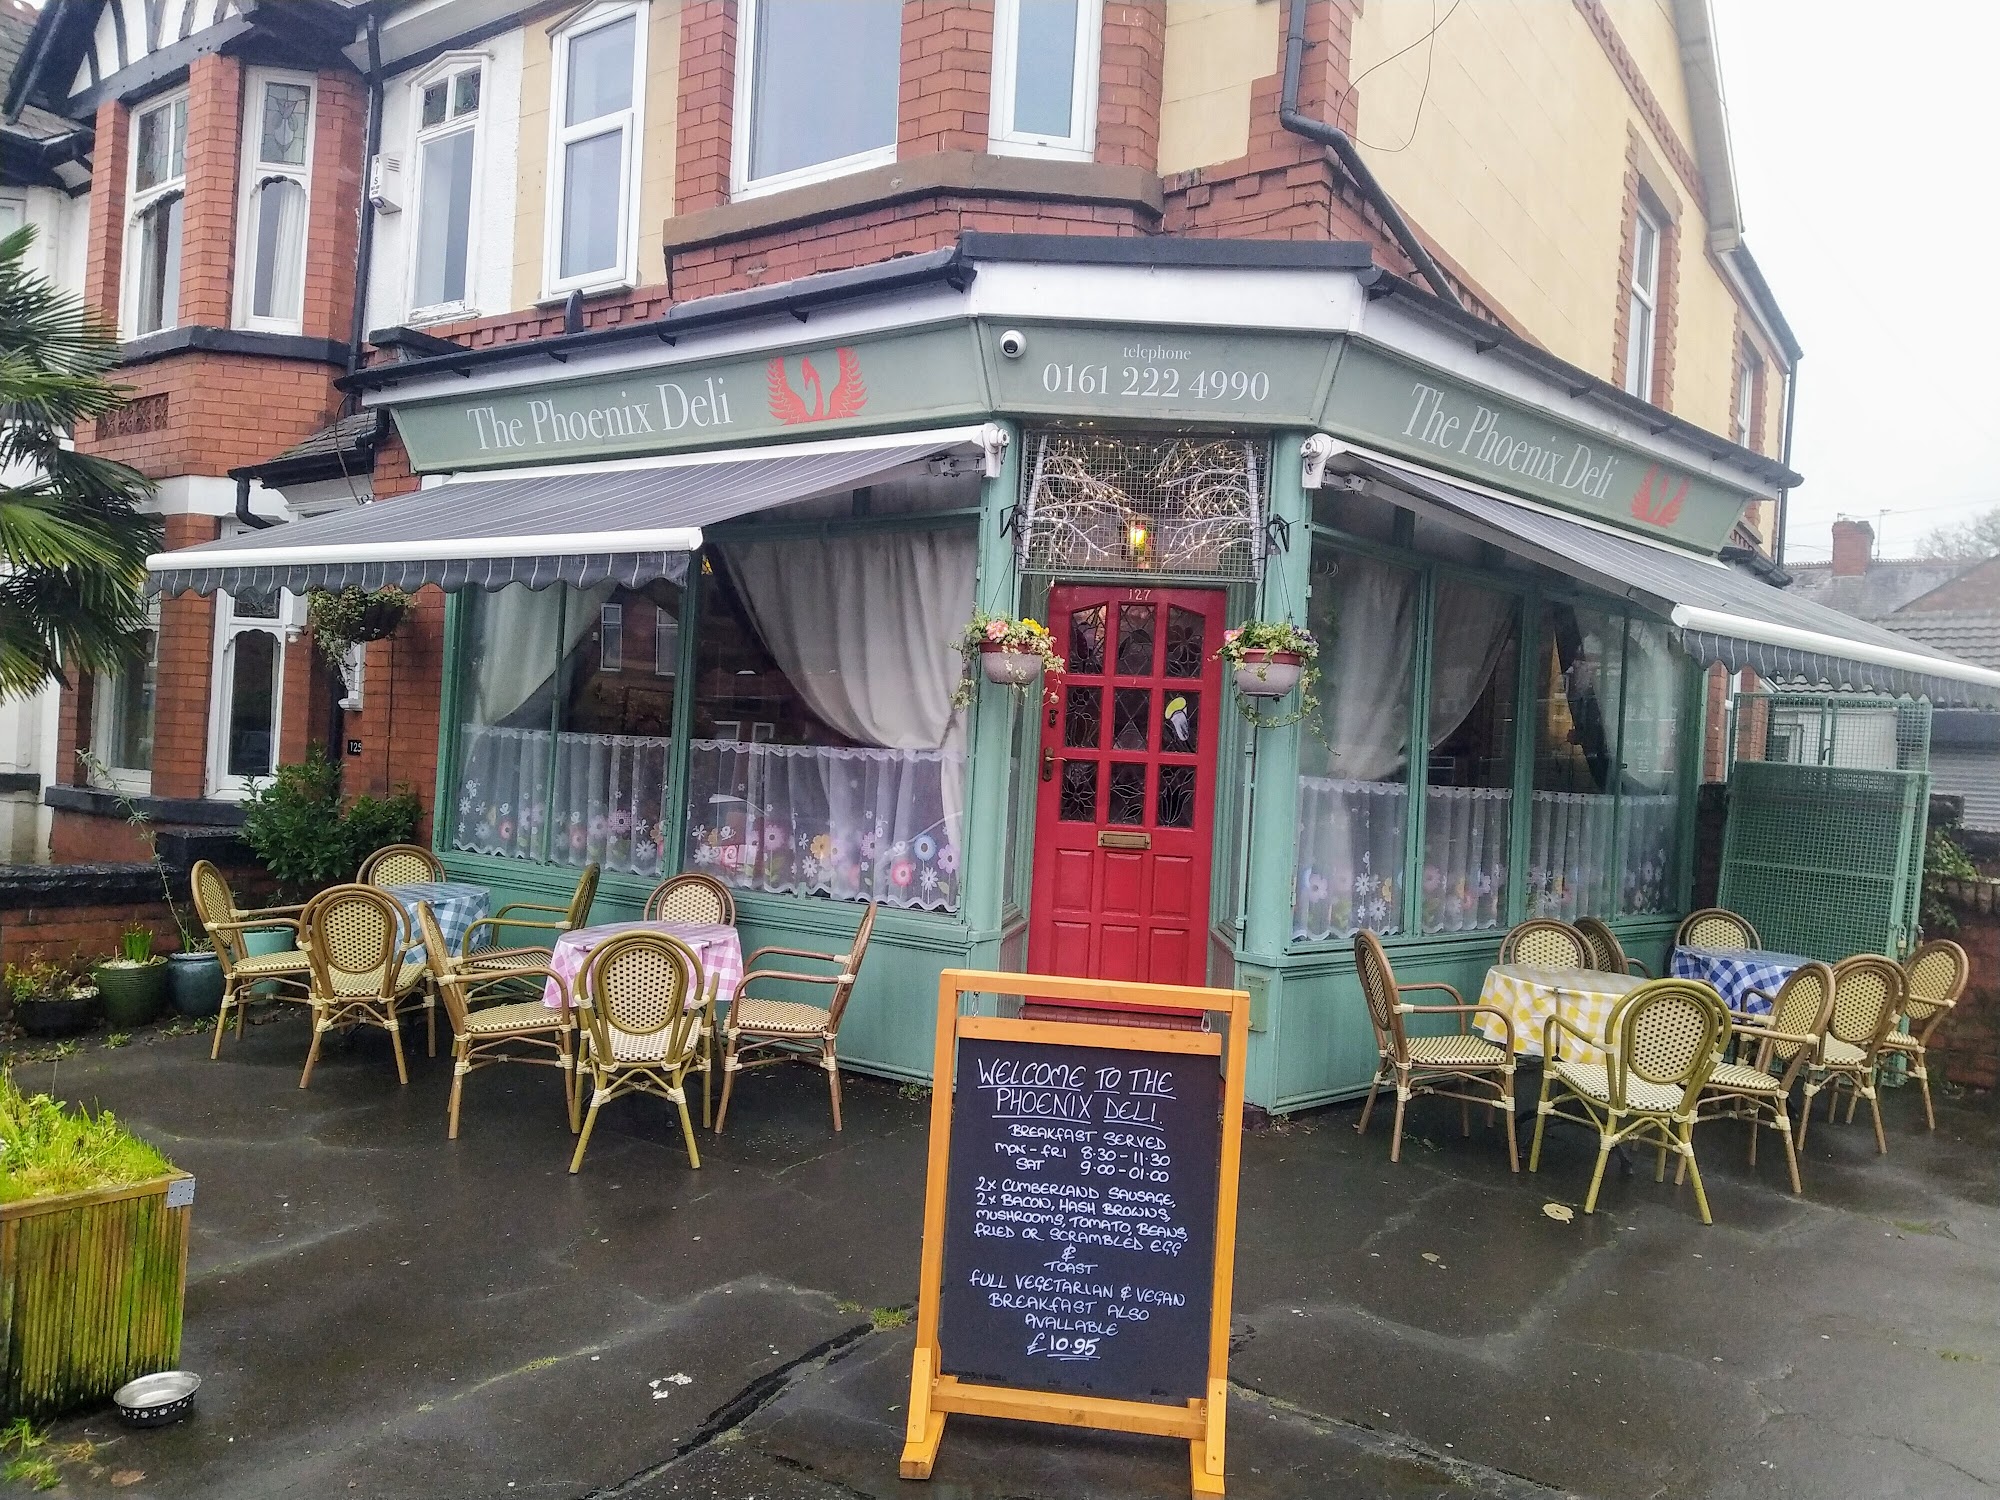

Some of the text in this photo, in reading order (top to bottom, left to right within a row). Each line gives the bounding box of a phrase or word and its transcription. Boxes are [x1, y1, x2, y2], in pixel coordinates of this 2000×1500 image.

[1123, 345, 1192, 364] telephone
[1042, 362, 1270, 402] 0161 222 4990
[466, 377, 734, 450] The Phoenix Deli
[1402, 382, 1619, 500] The Phoenix Deli
[1129, 588, 1151, 601] 127
[977, 1058, 1174, 1094] WELCOME TO THE
[996, 1087, 1093, 1119] PHOENIX
[1008, 1124, 1166, 1150] BREAKFAST SERVED
[1015, 1158, 1045, 1171] SAT
[1000, 1193, 1055, 1211] BACON,
[1059, 1199, 1096, 1215] HASH
[1102, 1203, 1171, 1222] BROWNS,
[1001, 1178, 1100, 1199] CUMBERLAND
[1108, 1187, 1176, 1208] SAUSAGE,
[1022, 1227, 1045, 1241] OR
[1050, 1228, 1144, 1251] SCRAMBLED
[1150, 1240, 1182, 1257] EGG
[1136, 1224, 1189, 1242] BEANS,
[1061, 1243, 1076, 1261] &
[1043, 1261, 1098, 1275] TOAST
[1015, 1274, 1114, 1298] VEGETARIAN
[1120, 1283, 1133, 1301] &
[1136, 1289, 1186, 1307] VEGAN
[988, 1293, 1150, 1321] BREAKFAST ALSO
